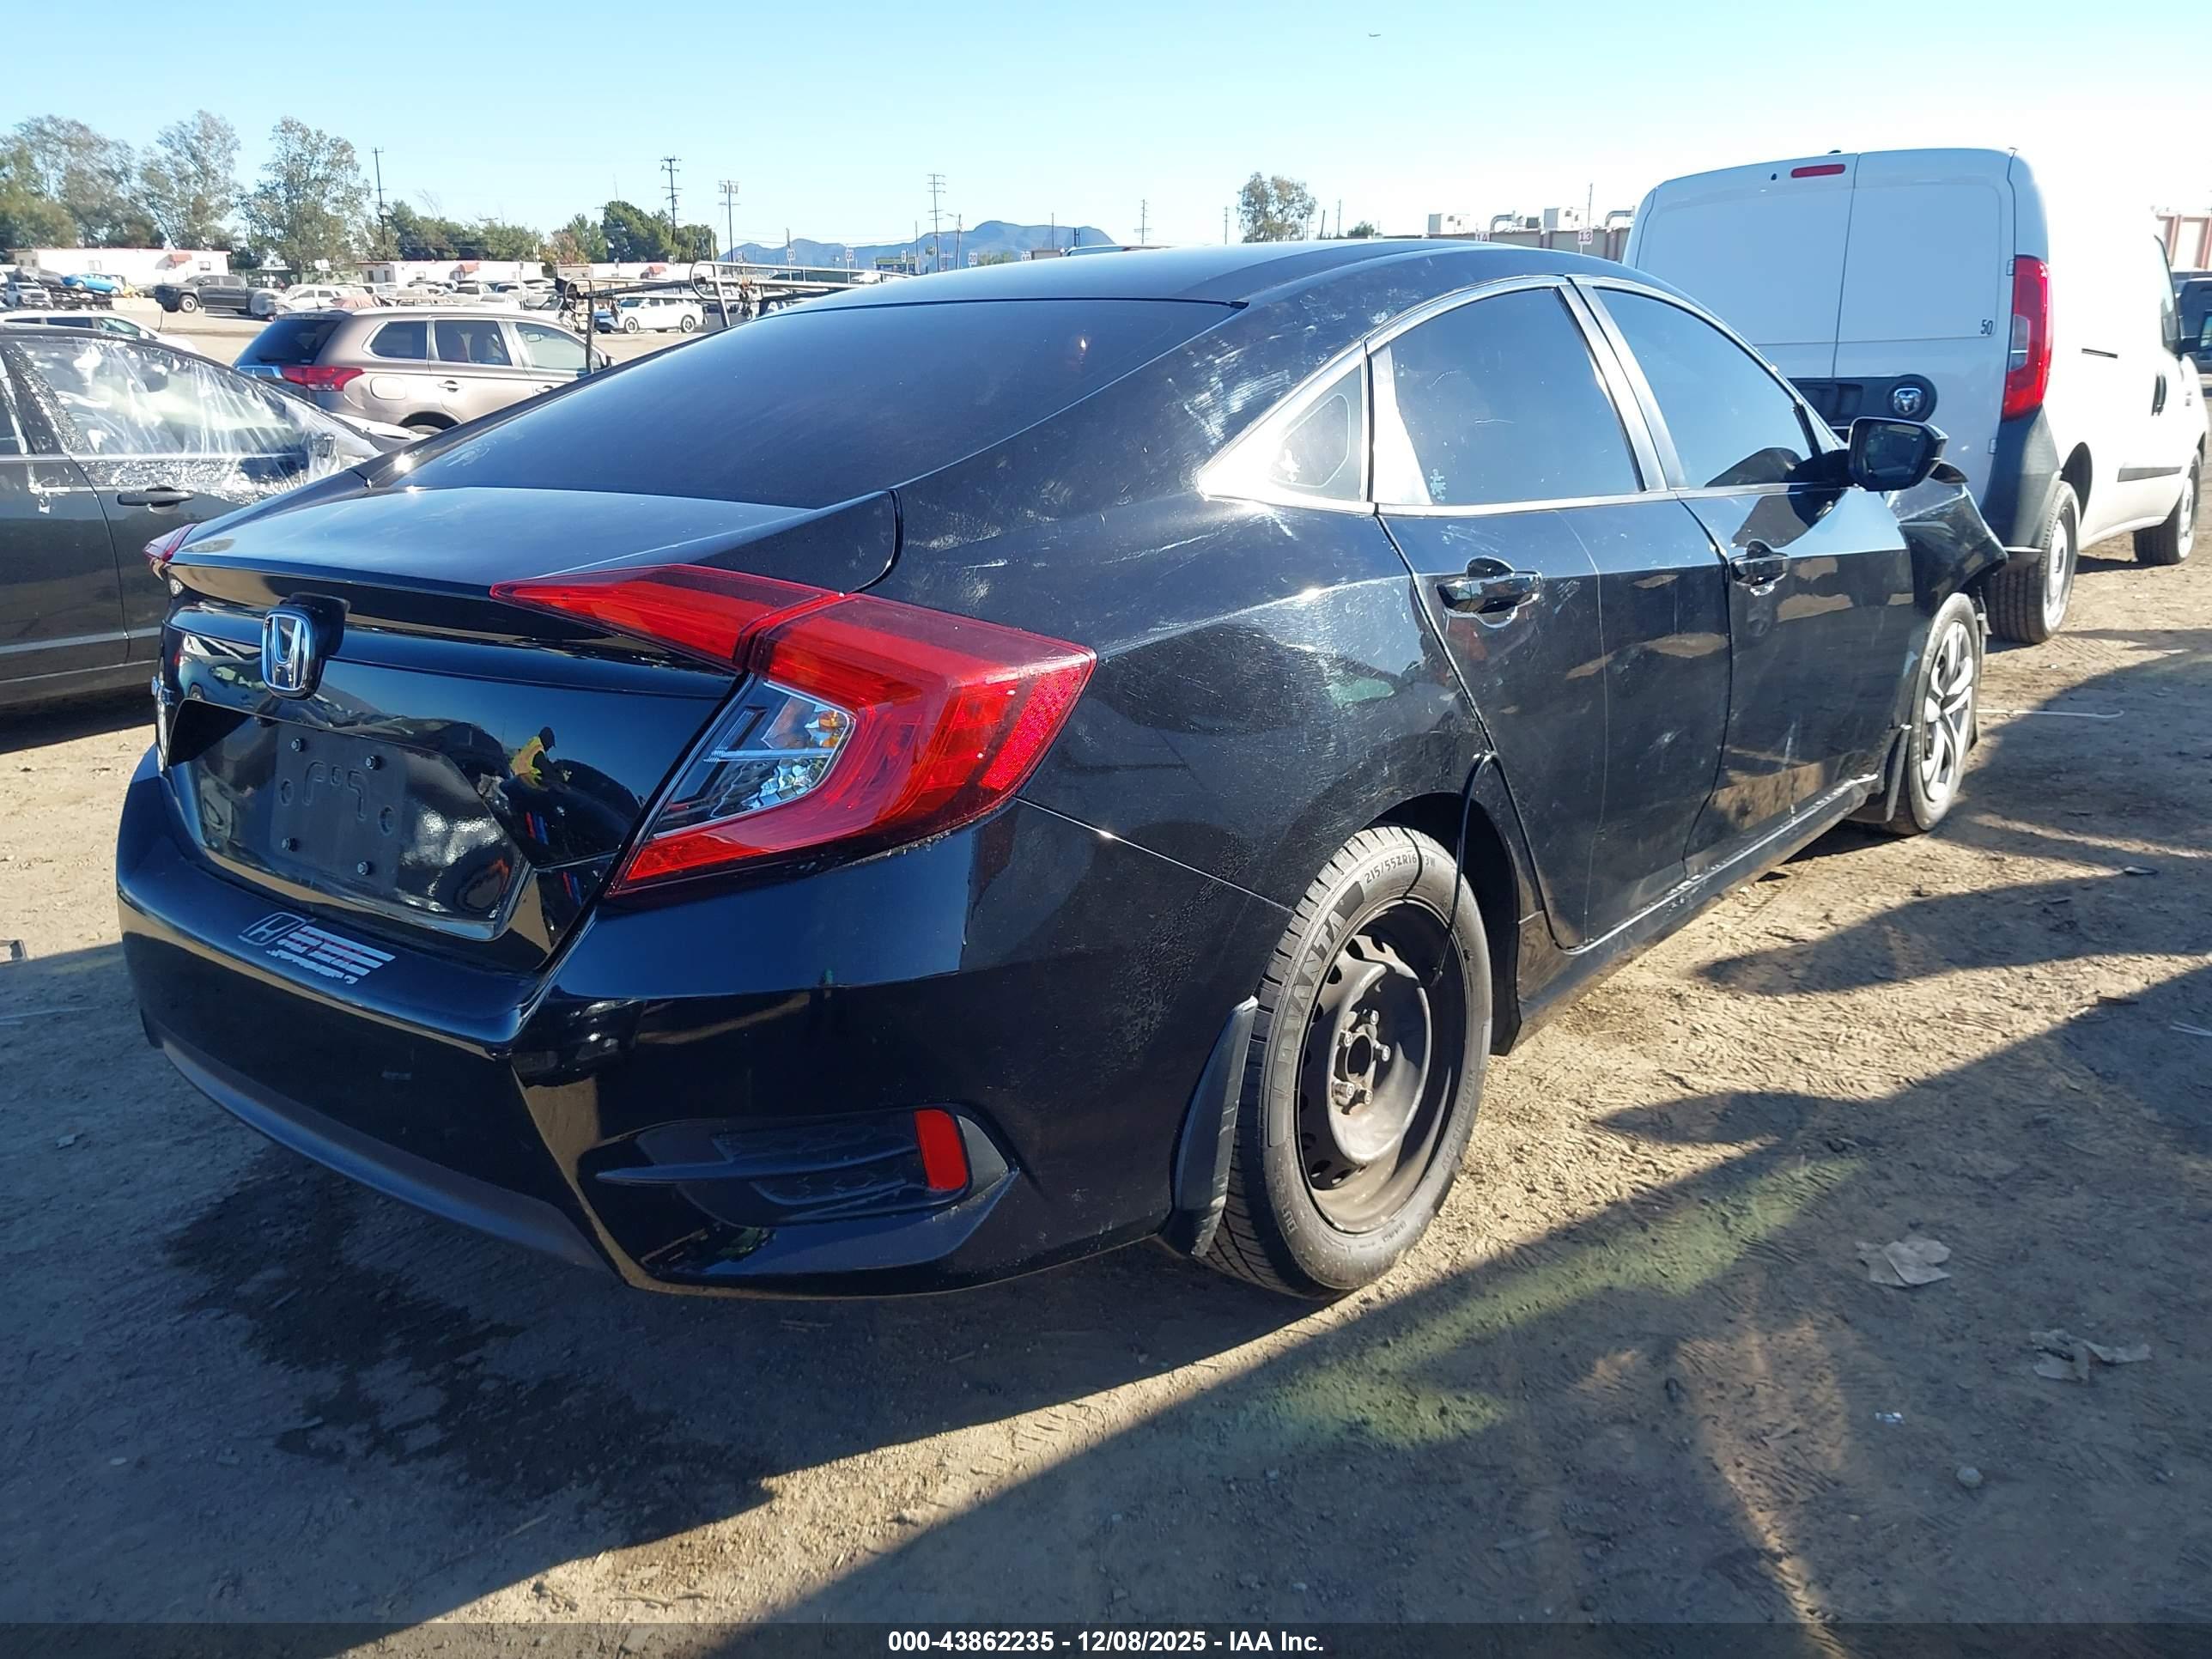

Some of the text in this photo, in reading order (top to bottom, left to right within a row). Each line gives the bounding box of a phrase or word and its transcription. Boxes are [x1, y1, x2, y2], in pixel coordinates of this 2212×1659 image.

[1579, 232, 1592, 241] 13
[1980, 319, 1993, 335] 50
[1364, 853, 1417, 884] 215/55ZR16
